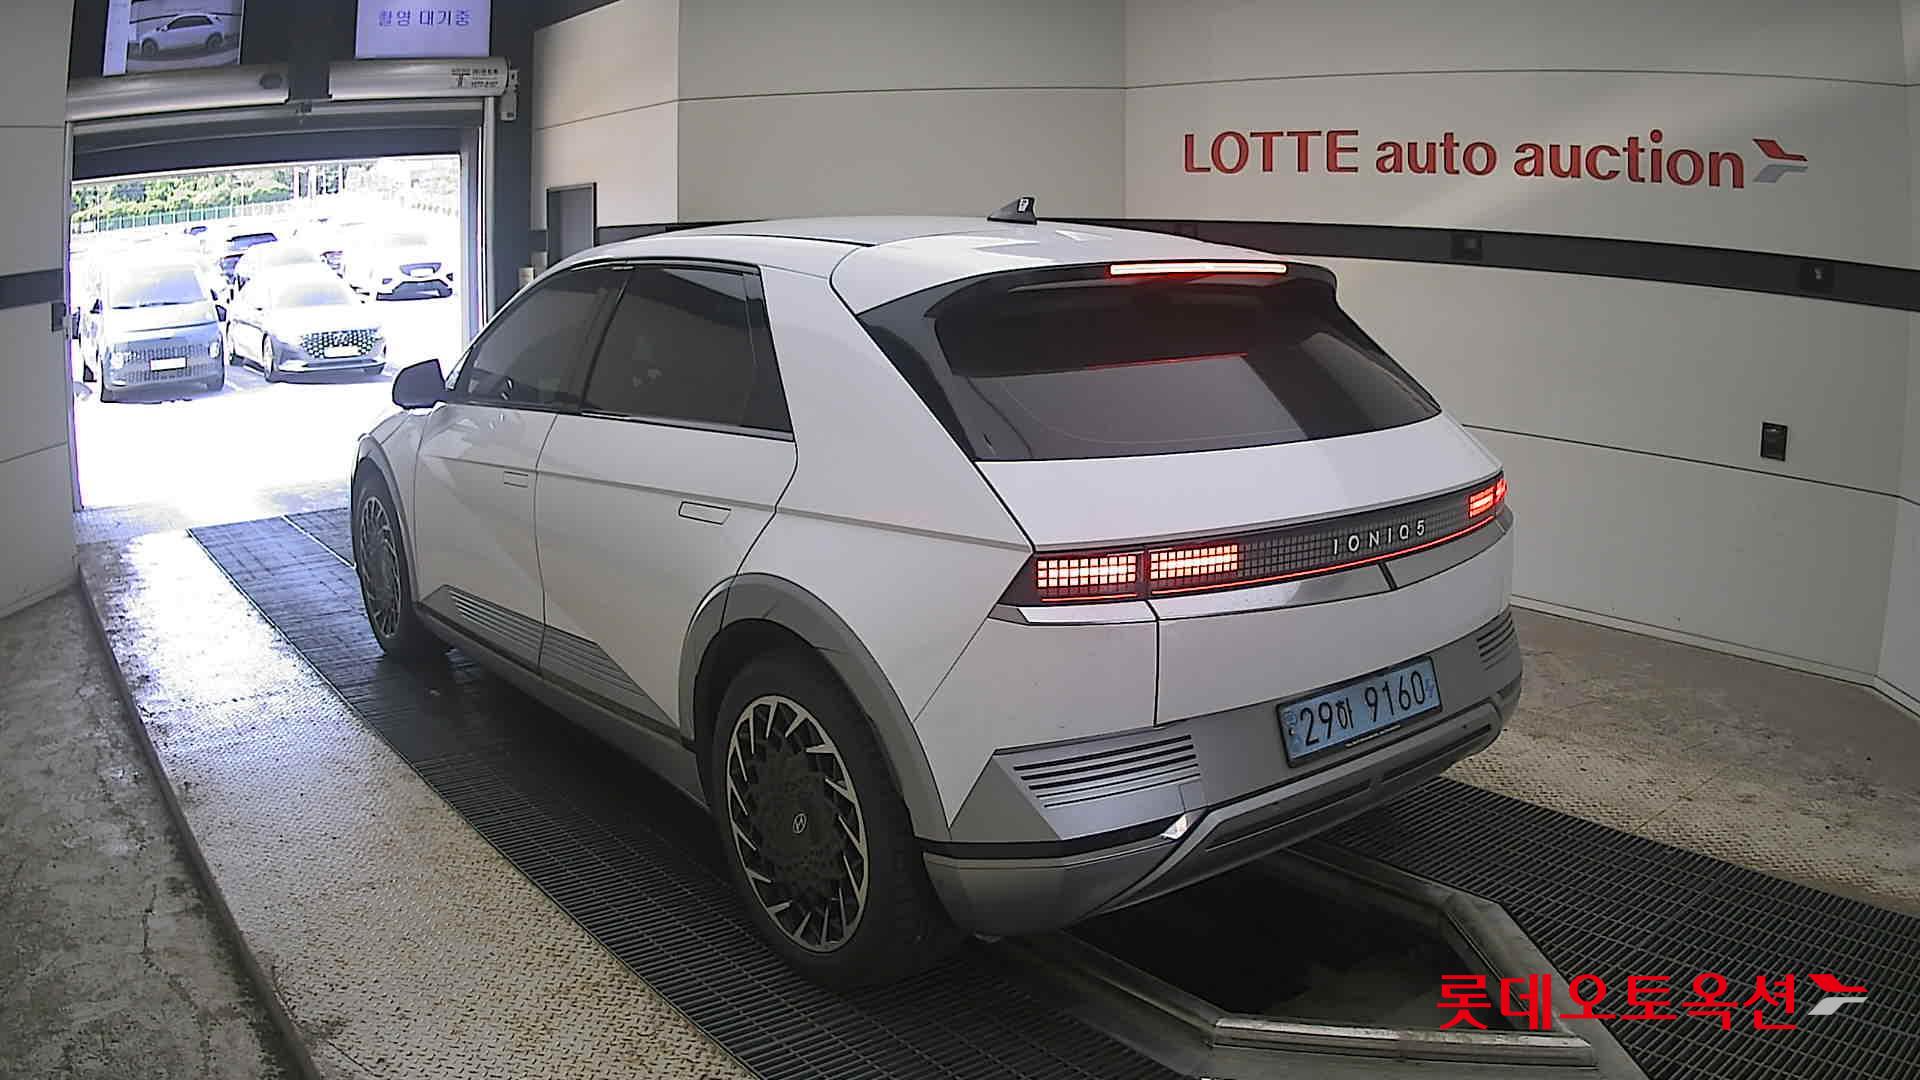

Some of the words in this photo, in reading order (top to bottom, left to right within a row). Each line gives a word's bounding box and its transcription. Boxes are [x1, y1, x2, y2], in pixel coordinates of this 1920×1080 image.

[419, 9, 472, 26] 대기중
[1184, 130, 1359, 174] LOTTE
[1377, 132, 1498, 175] auto
[1514, 130, 1745, 188] auction
[1364, 670, 1426, 722] 9160
